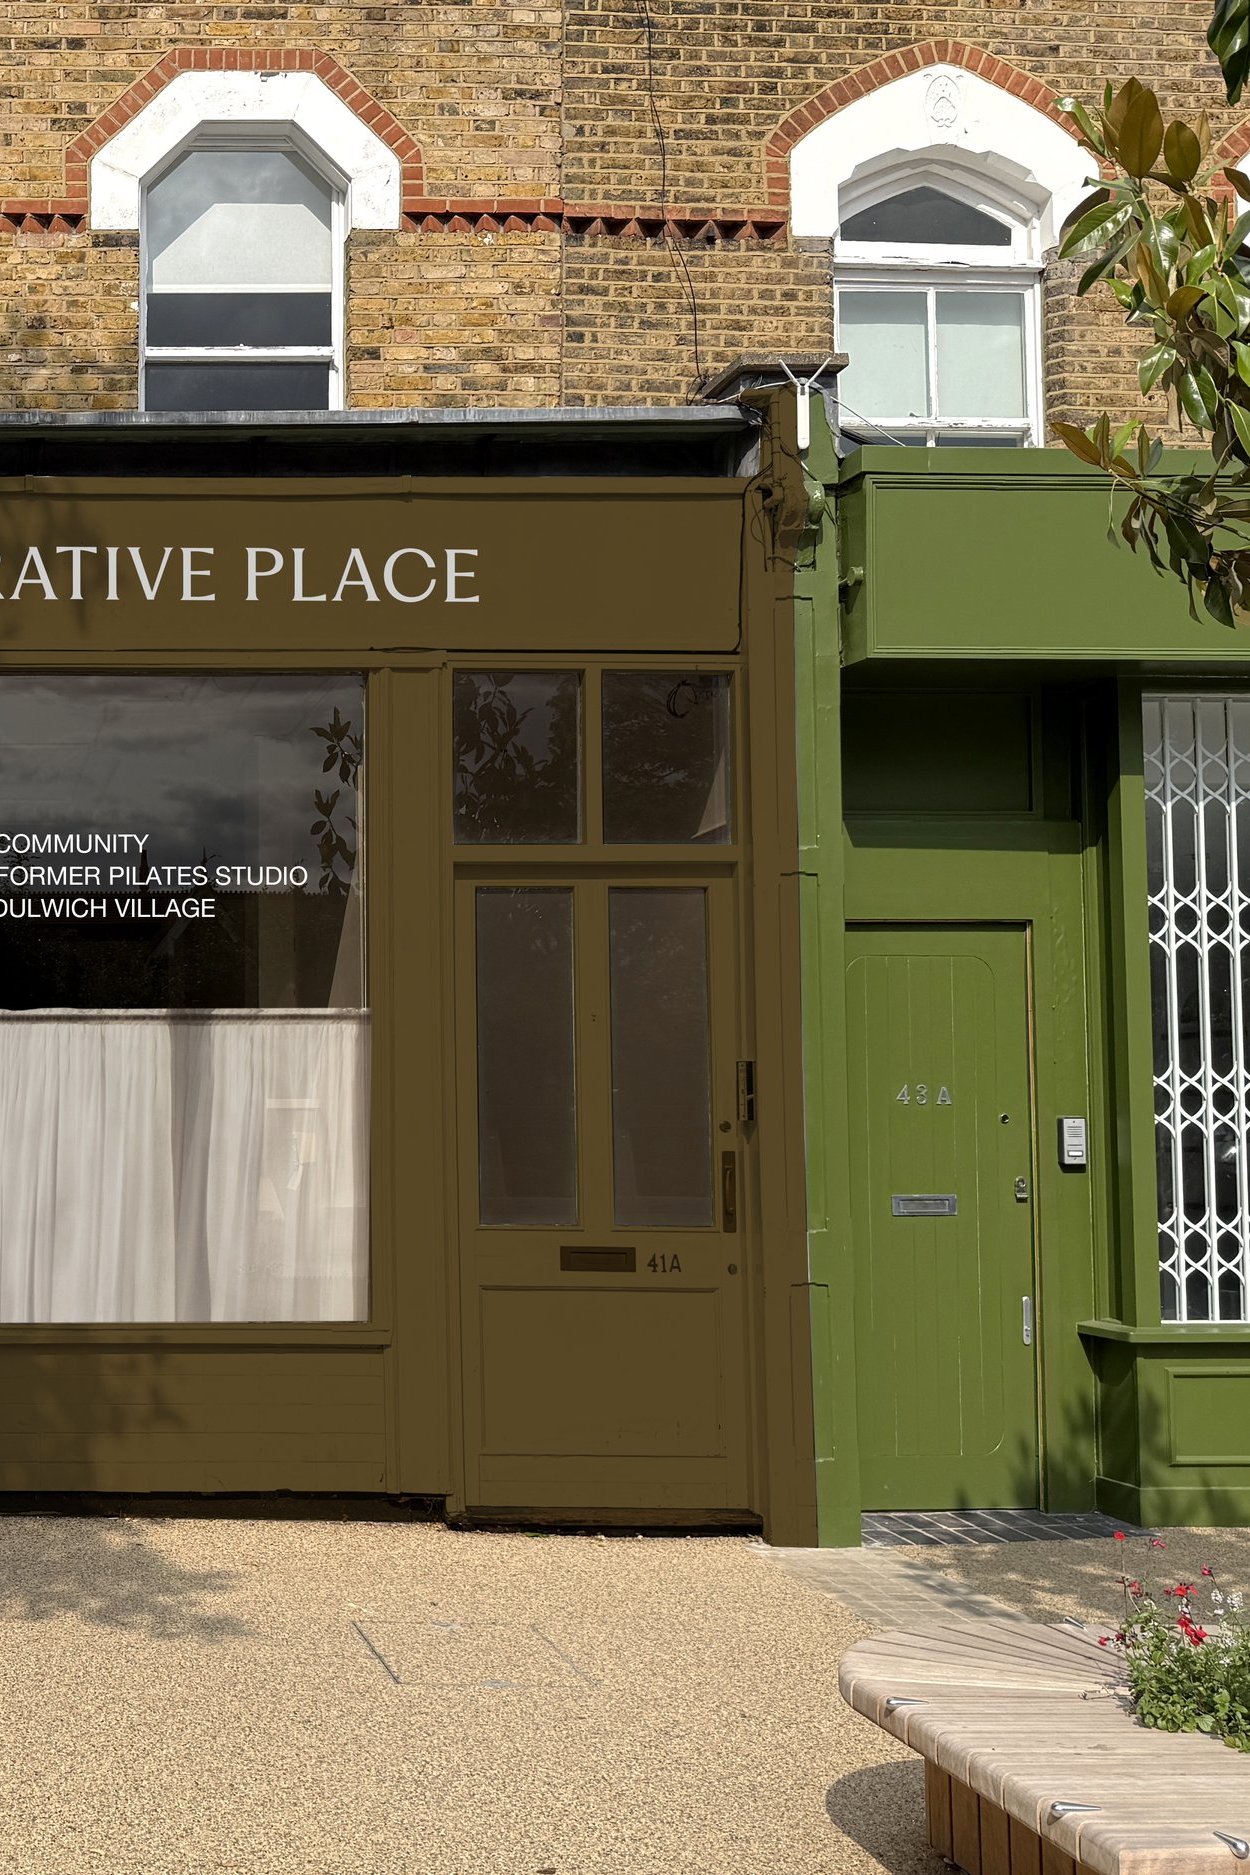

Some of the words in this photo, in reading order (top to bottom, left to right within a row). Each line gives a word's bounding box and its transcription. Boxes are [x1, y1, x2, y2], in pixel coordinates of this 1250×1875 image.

[245, 547, 481, 604] PLACE
[109, 865, 208, 886] PILATES
[215, 865, 308, 886] STUDIO
[114, 898, 216, 918] VILLAGE
[646, 1252, 682, 1273] 41A
